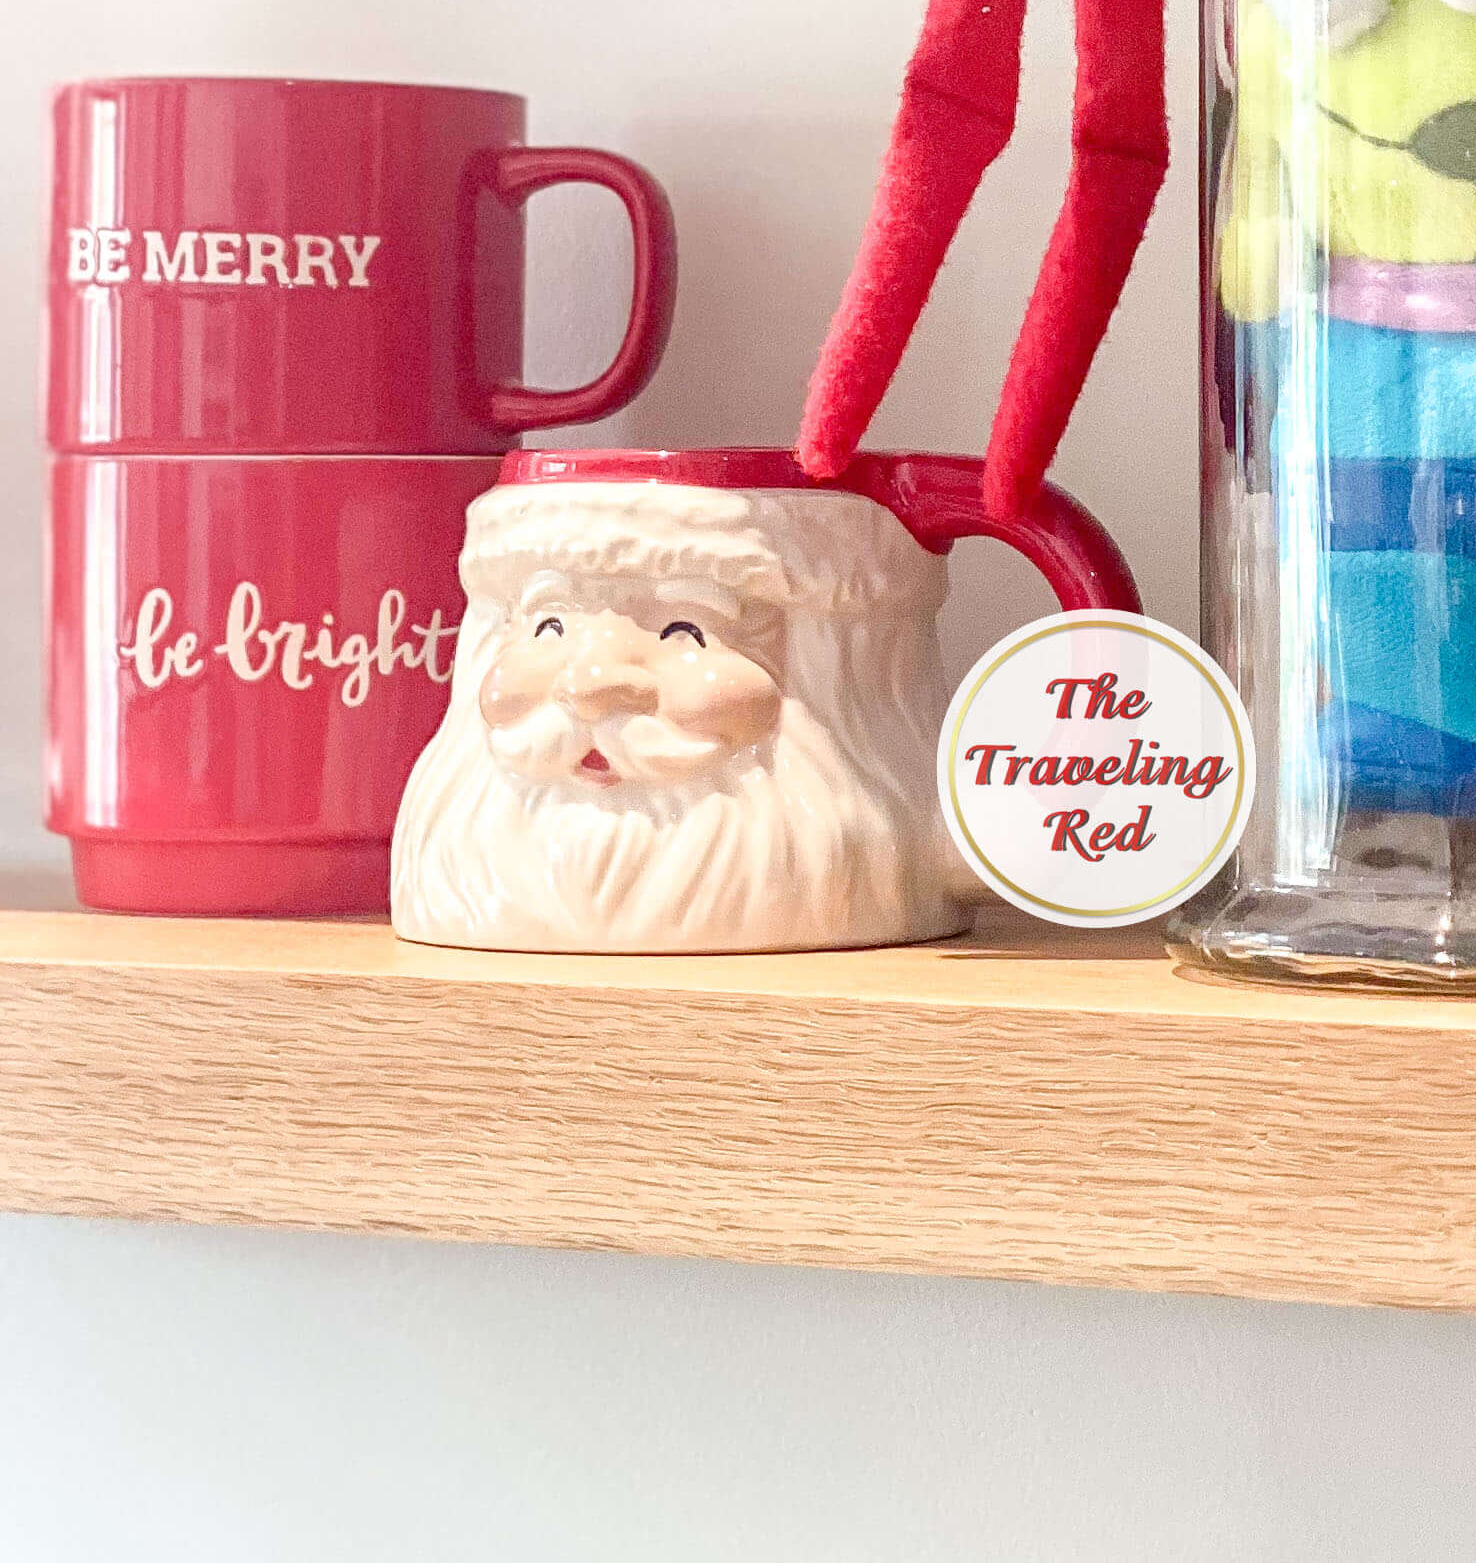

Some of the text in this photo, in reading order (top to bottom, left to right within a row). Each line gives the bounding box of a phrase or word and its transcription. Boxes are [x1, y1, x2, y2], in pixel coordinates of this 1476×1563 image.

[67, 227, 381, 288] BE MERRY
[119, 580, 461, 709] be bright
